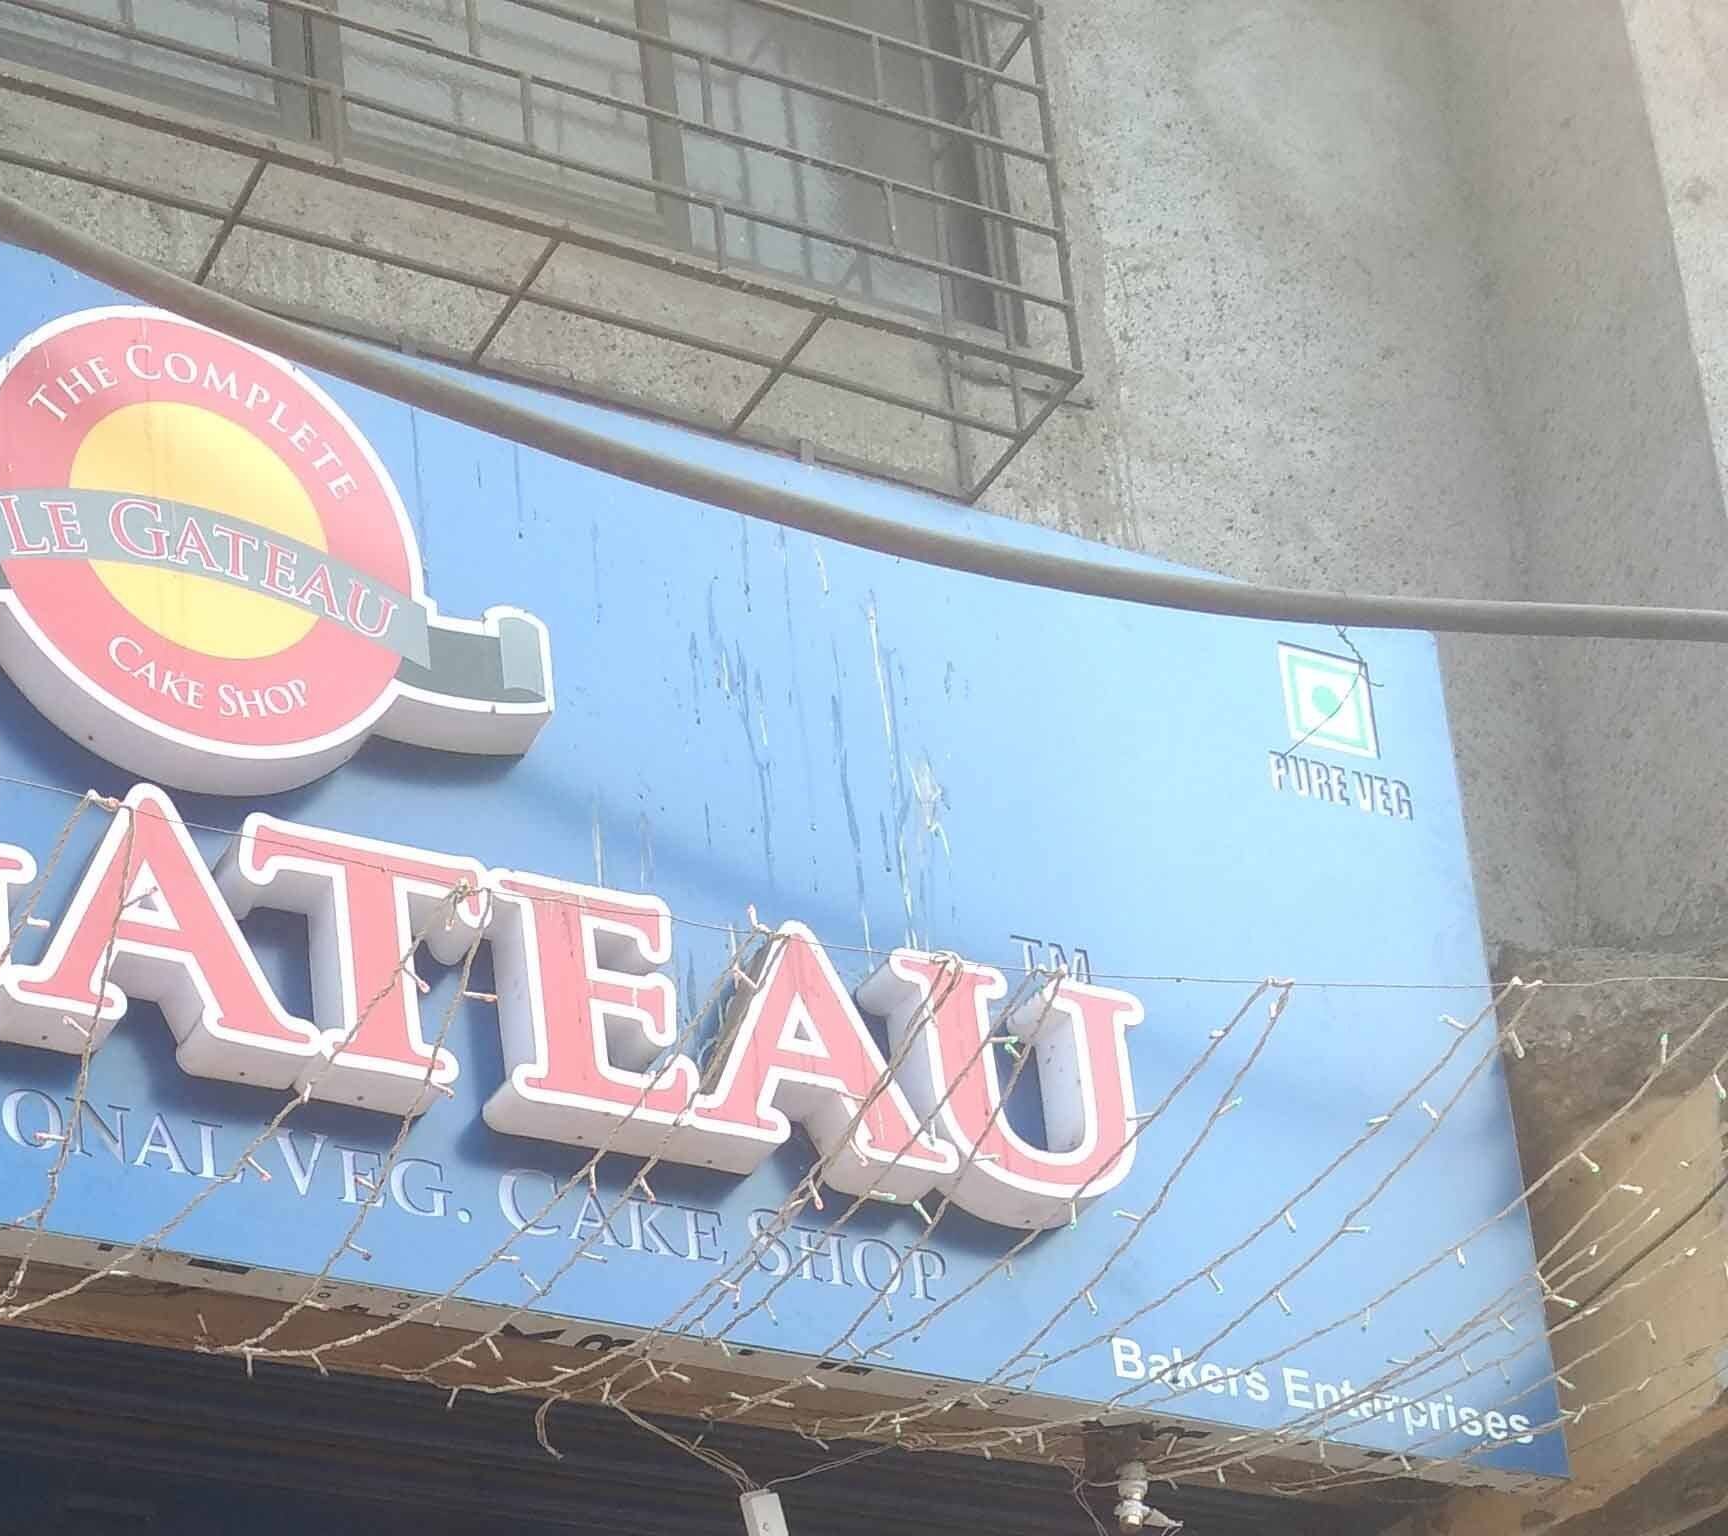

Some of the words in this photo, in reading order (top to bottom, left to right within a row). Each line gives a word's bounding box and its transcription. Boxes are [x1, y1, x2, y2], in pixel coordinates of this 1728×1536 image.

[26, 354, 120, 426] THE
[125, 343, 361, 503] COMPLETE
[108, 498, 400, 641] GATEAU
[108, 635, 205, 712] CAKE
[217, 679, 310, 718] SHOP
[1268, 749, 1350, 806] PURE
[1352, 770, 1414, 821] VEG
[264, 1121, 473, 1224] VEG.
[496, 1168, 730, 1266] CAKE
[745, 1206, 947, 1302] SHOP
[1111, 1336, 1271, 1403] Bakers
